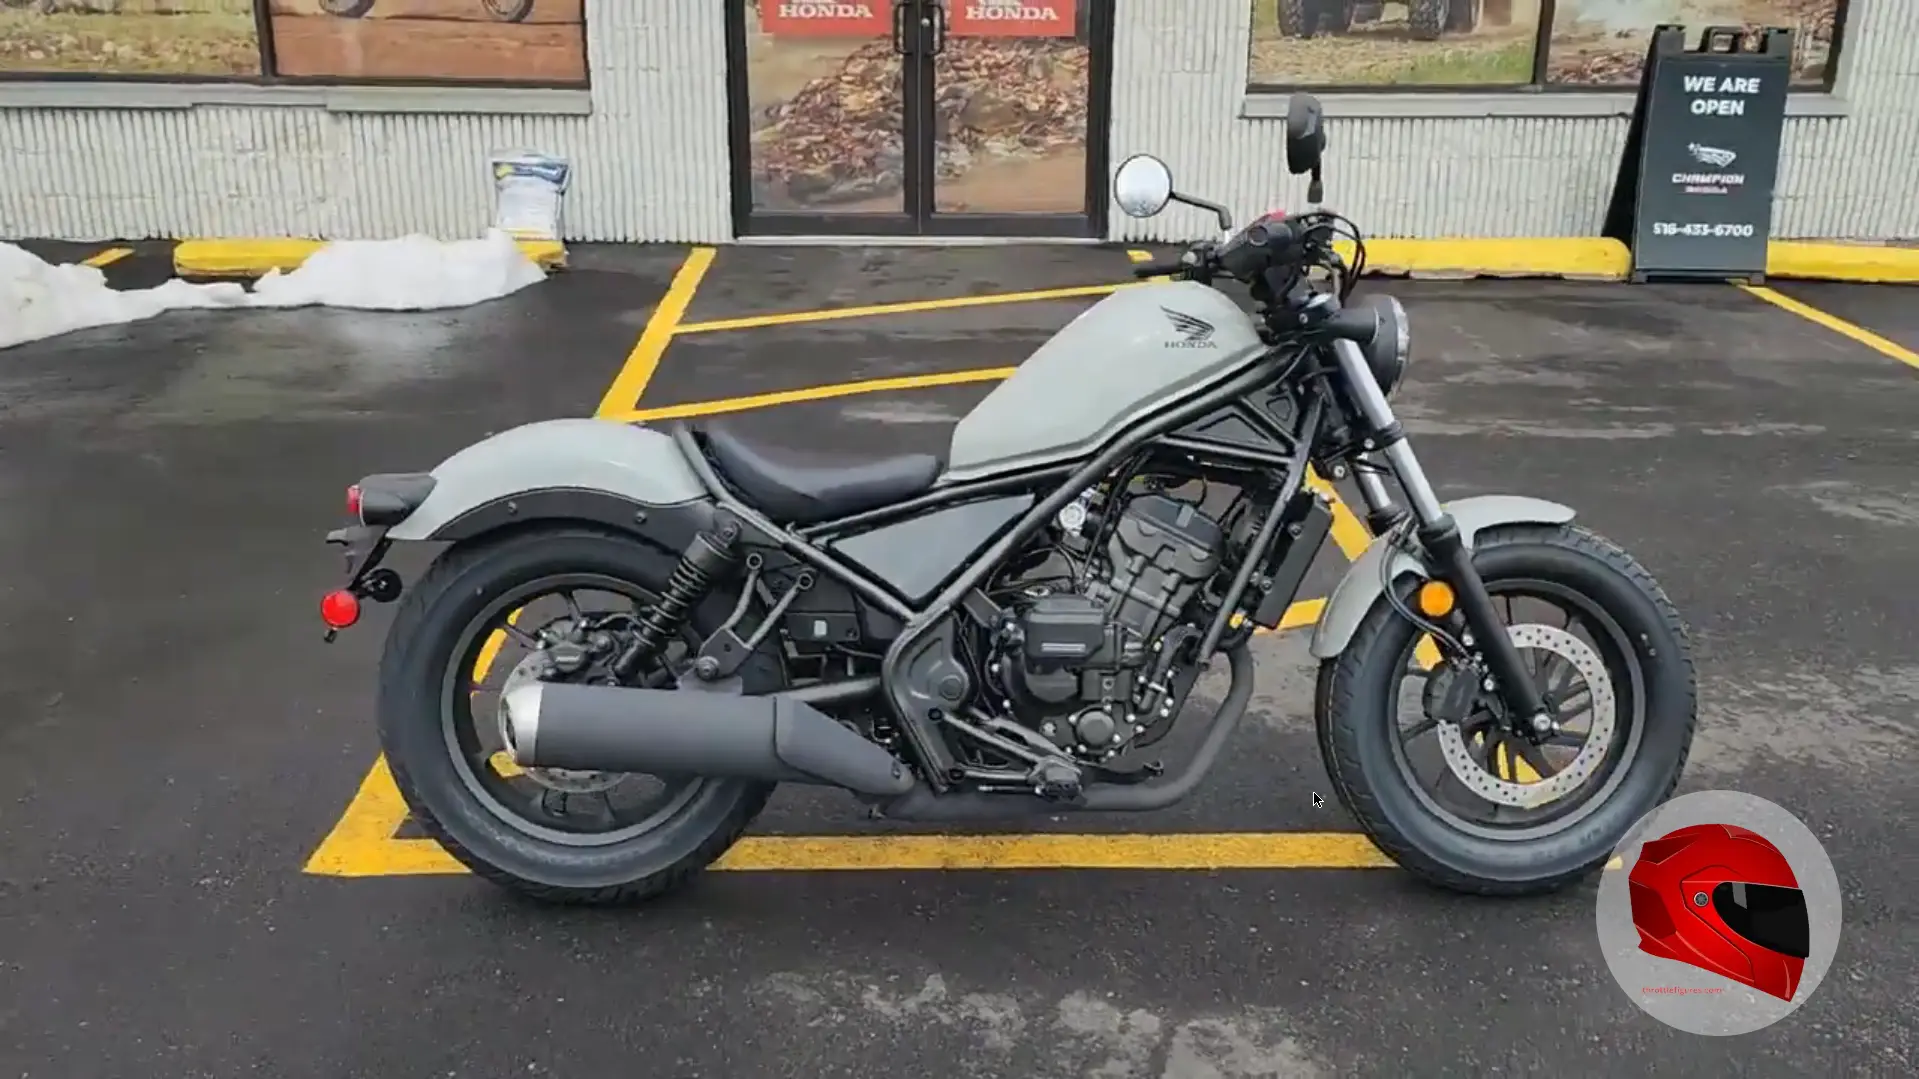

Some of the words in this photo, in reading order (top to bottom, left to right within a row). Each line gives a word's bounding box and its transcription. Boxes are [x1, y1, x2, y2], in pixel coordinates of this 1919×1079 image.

[778, 5, 873, 18] HONDA
[965, 6, 1060, 21] HONDA
[1684, 75, 1716, 92] WE
[1720, 77, 1761, 94] ARE
[1691, 99, 1745, 115] OPEN
[1672, 173, 1745, 184] CHAMPION
[1653, 222, 1754, 237] 516-433-6700
[1164, 341, 1218, 349] HONDA
